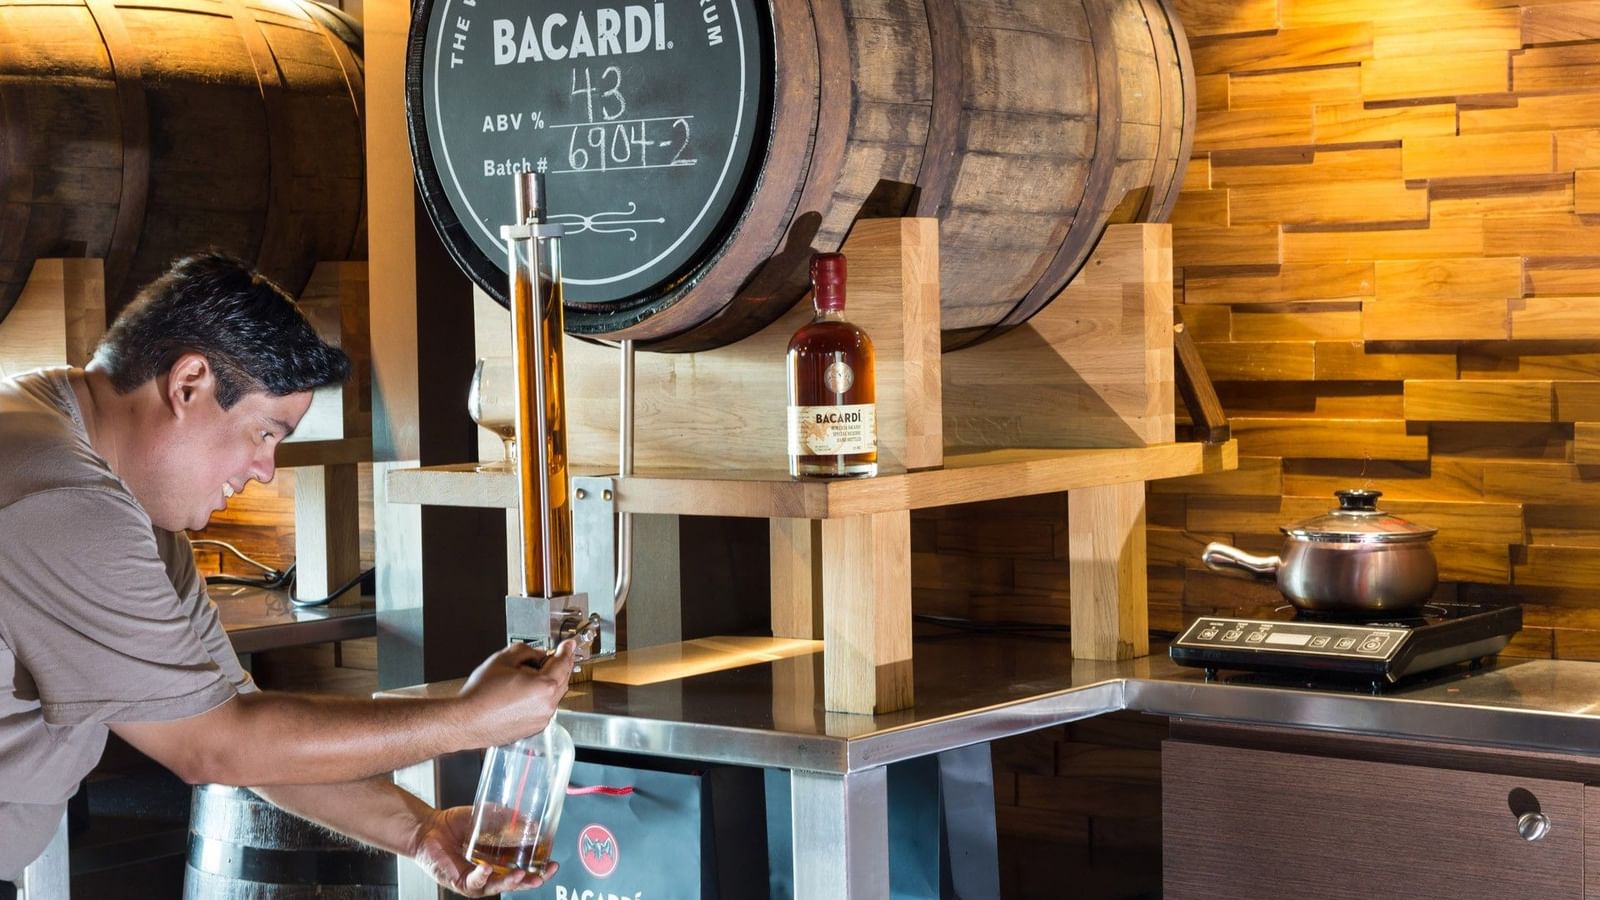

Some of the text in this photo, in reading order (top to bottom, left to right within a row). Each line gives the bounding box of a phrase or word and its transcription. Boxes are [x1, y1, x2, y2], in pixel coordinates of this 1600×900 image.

[450, 16, 470, 69] THE
[571, 65, 626, 123] 43
[482, 111, 545, 133] ABV %
[568, 118, 698, 172] 6904-2
[483, 156, 548, 177] Batch #
